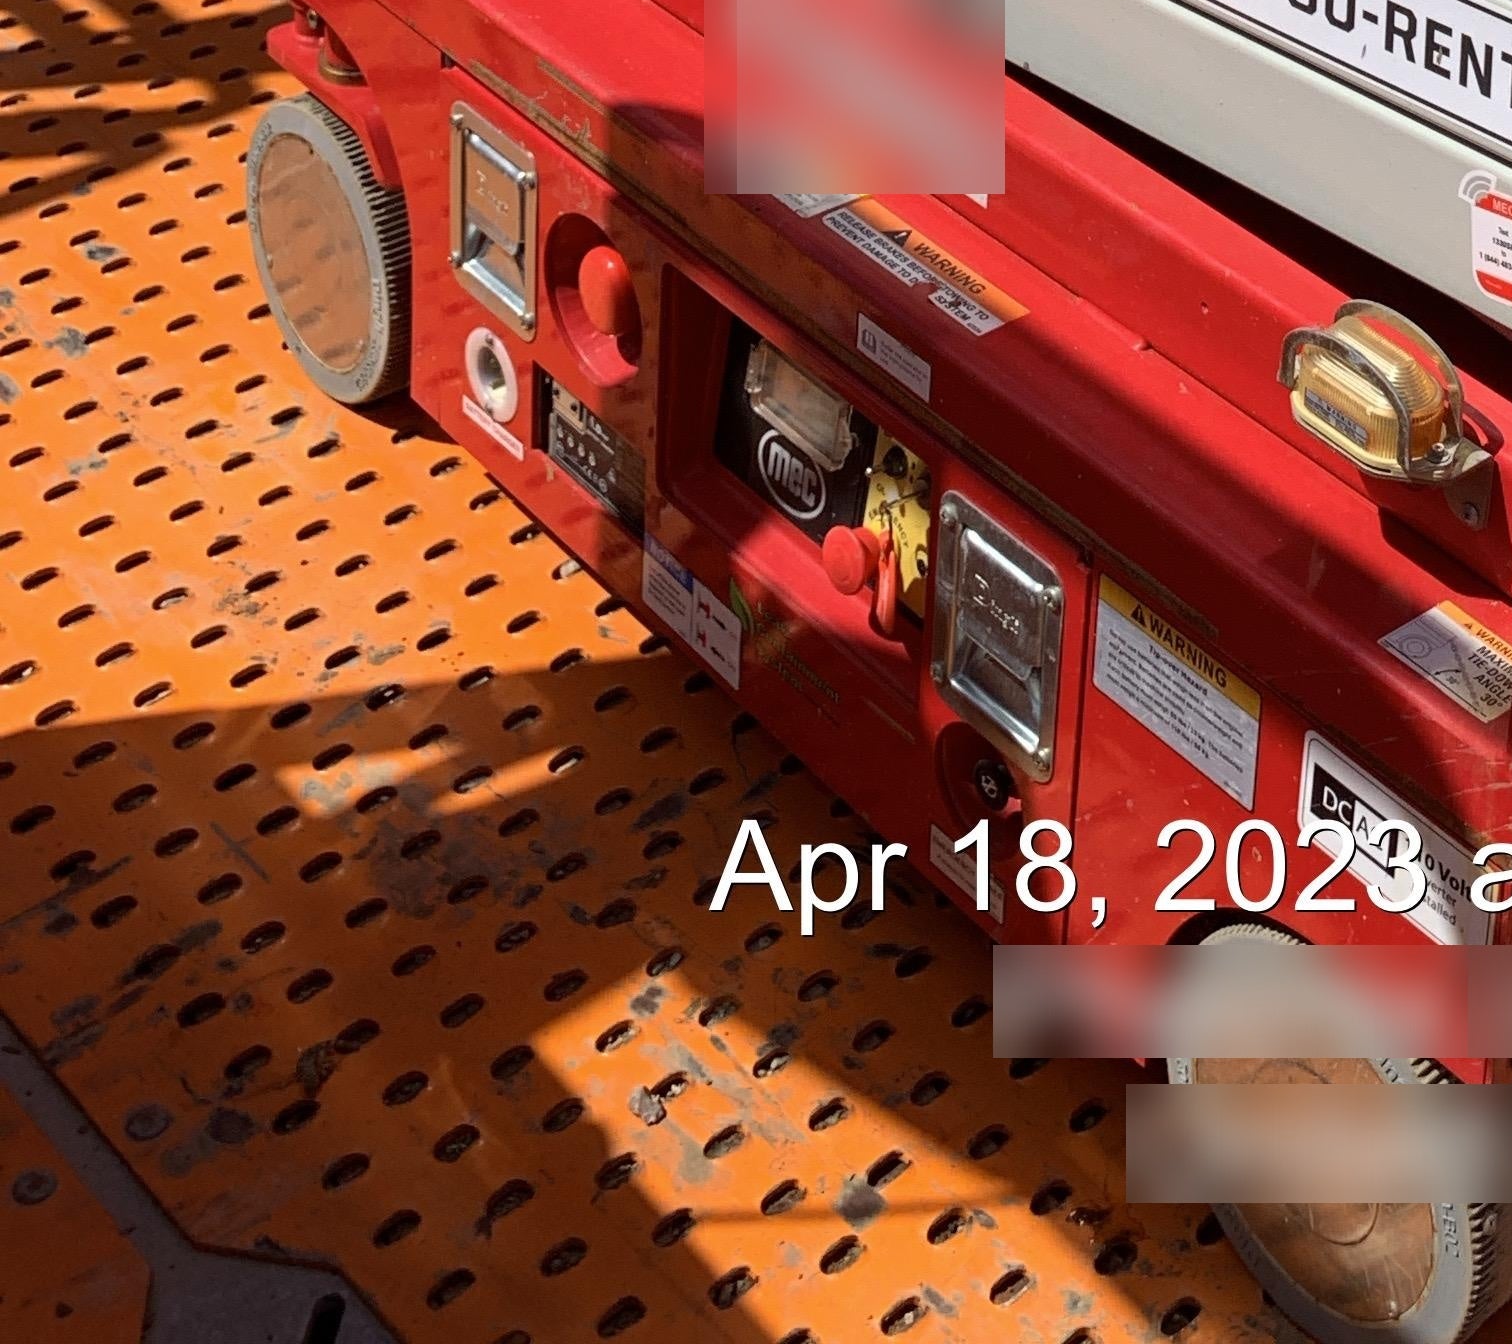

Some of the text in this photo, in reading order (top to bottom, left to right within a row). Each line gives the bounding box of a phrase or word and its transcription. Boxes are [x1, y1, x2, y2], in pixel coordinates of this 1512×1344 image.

[827, 216, 911, 278] PREVENT DAMAGE TO
[837, 211, 876, 241] RELEASE
[874, 235, 908, 263] BRAKES
[974, 306, 990, 321] TO
[914, 242, 987, 295] WARNING
[1150, 618, 1227, 689] WARNING
[1473, 674, 1512, 704] ANGLE
[1322, 785, 1353, 826] DC
